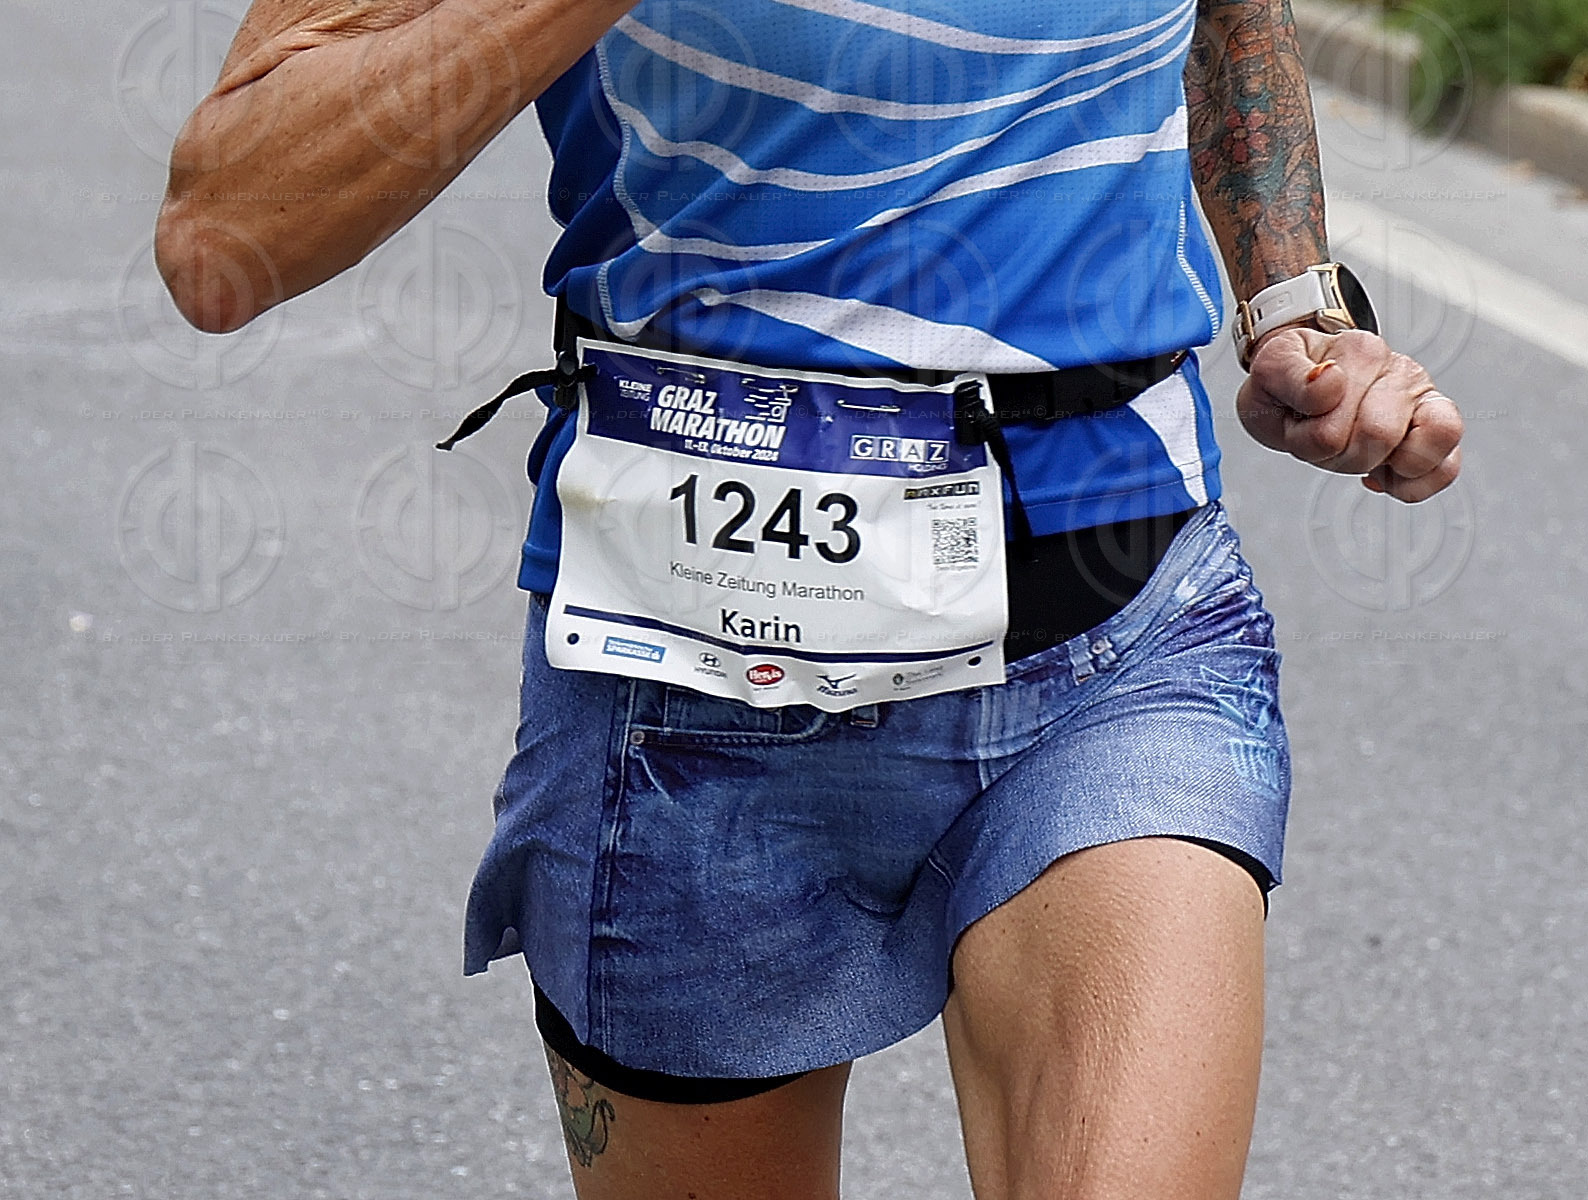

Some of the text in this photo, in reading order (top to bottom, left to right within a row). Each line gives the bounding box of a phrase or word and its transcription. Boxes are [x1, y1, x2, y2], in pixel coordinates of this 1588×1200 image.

[657, 385, 717, 415] GRAZ
[649, 407, 787, 449] MARATHON
[853, 439, 945, 461] GRAZ
[670, 475, 861, 564] 1243
[670, 561, 865, 601] Kleine Zeitung Marathon
[721, 608, 801, 643] Karin
